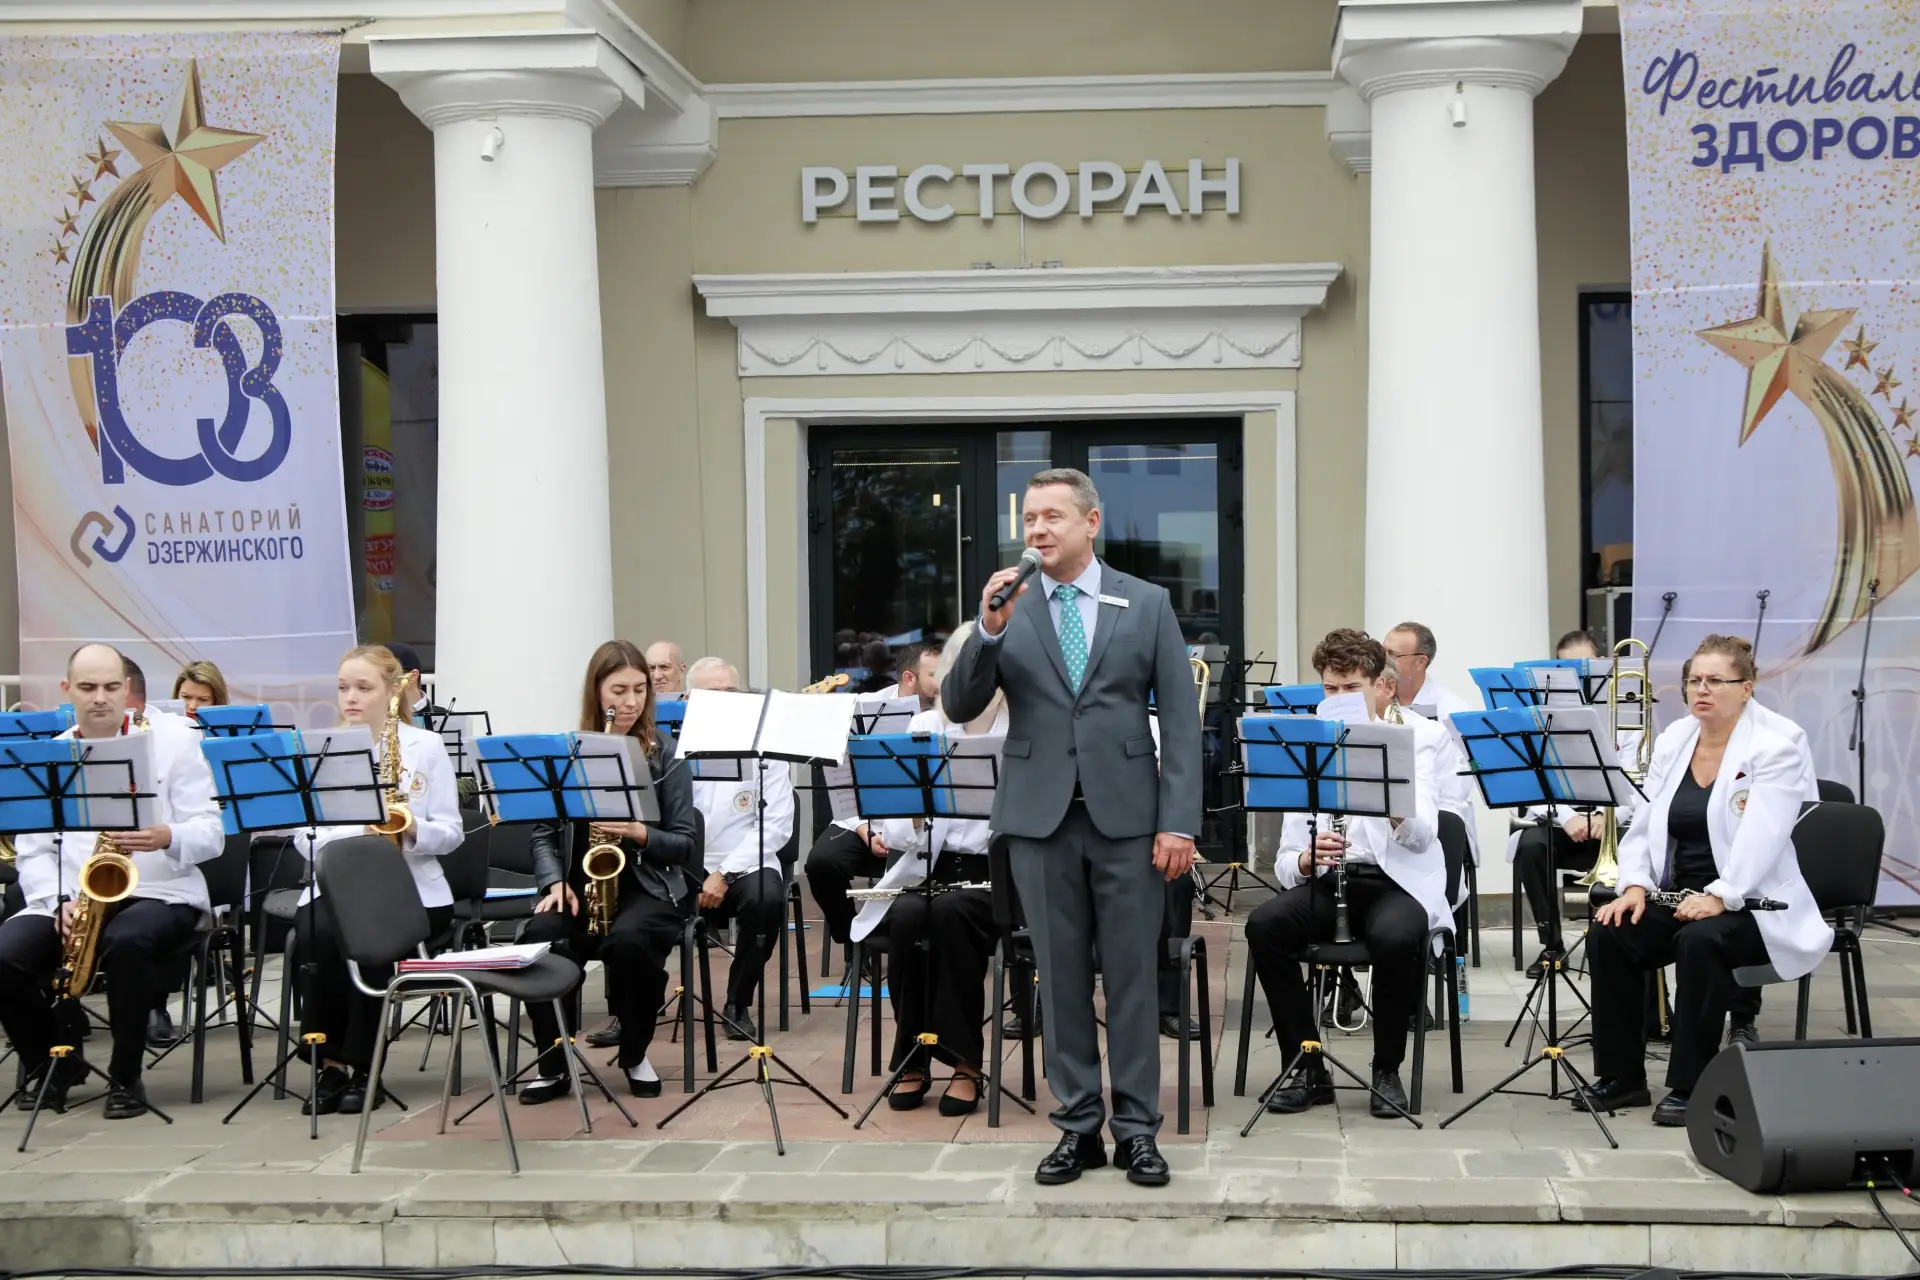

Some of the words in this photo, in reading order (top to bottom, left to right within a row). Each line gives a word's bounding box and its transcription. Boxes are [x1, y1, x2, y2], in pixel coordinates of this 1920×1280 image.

[1691, 116, 1920, 174] ЗДОРОВ
[801, 157, 1241, 223] РЕСТОРАН
[65, 290, 292, 486] 103
[145, 502, 301, 535] САНАТОРИЙ
